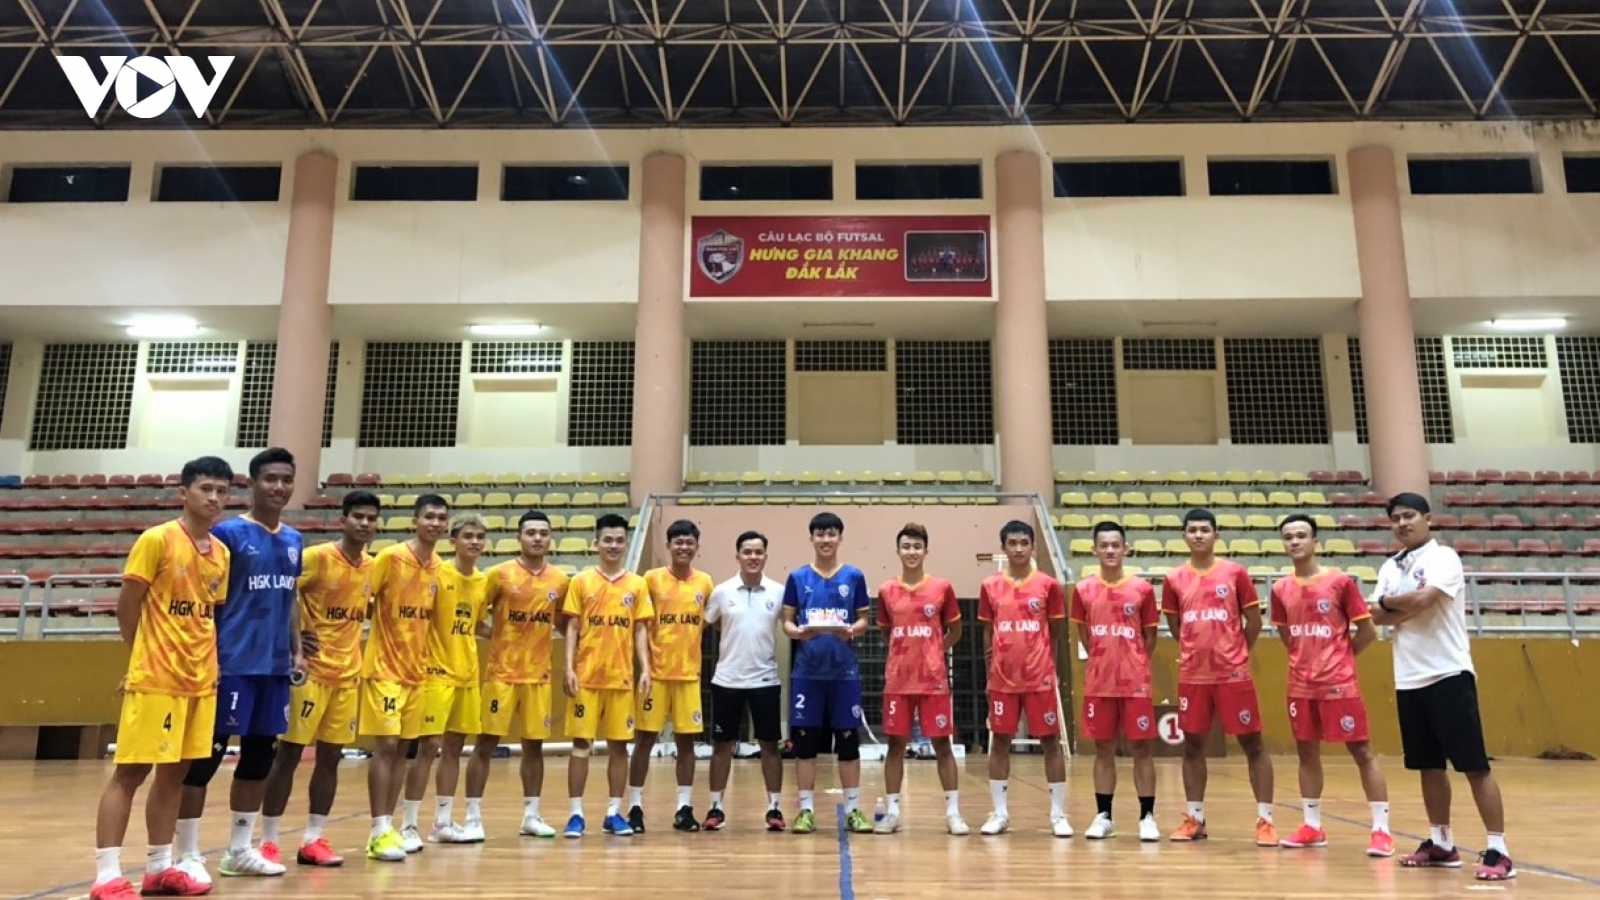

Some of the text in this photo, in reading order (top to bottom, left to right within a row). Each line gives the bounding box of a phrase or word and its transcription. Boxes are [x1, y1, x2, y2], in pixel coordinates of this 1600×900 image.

[788, 233, 812, 244] LẠC
[815, 230, 834, 243] BỘ
[837, 232, 884, 243] FUTSAL
[749, 247, 899, 261] HƯNG GIA KHANG
[248, 574, 272, 591] HGK
[168, 600, 195, 617] HGK
[326, 606, 348, 620] HGK
[399, 605, 418, 619] HGK
[508, 609, 527, 622] HGK
[1201, 608, 1228, 621] LAND
[588, 614, 630, 629] HGK LAND
[660, 613, 700, 626] HGK LAND
[1015, 620, 1040, 632] LAND
[907, 626, 932, 638] LAND
[1110, 625, 1135, 638] LAND
[1304, 624, 1331, 638] LAND
[383, 696, 396, 711] 14
[490, 699, 499, 713] 8
[795, 694, 805, 709] 2
[889, 701, 896, 715] 5
[993, 701, 1004, 715] 13
[301, 700, 315, 718] 17
[575, 703, 585, 718] 18
[1088, 703, 1095, 717] 3
[1290, 702, 1297, 717] 6
[163, 713, 172, 732] 4
[1167, 717, 1180, 740] 1
